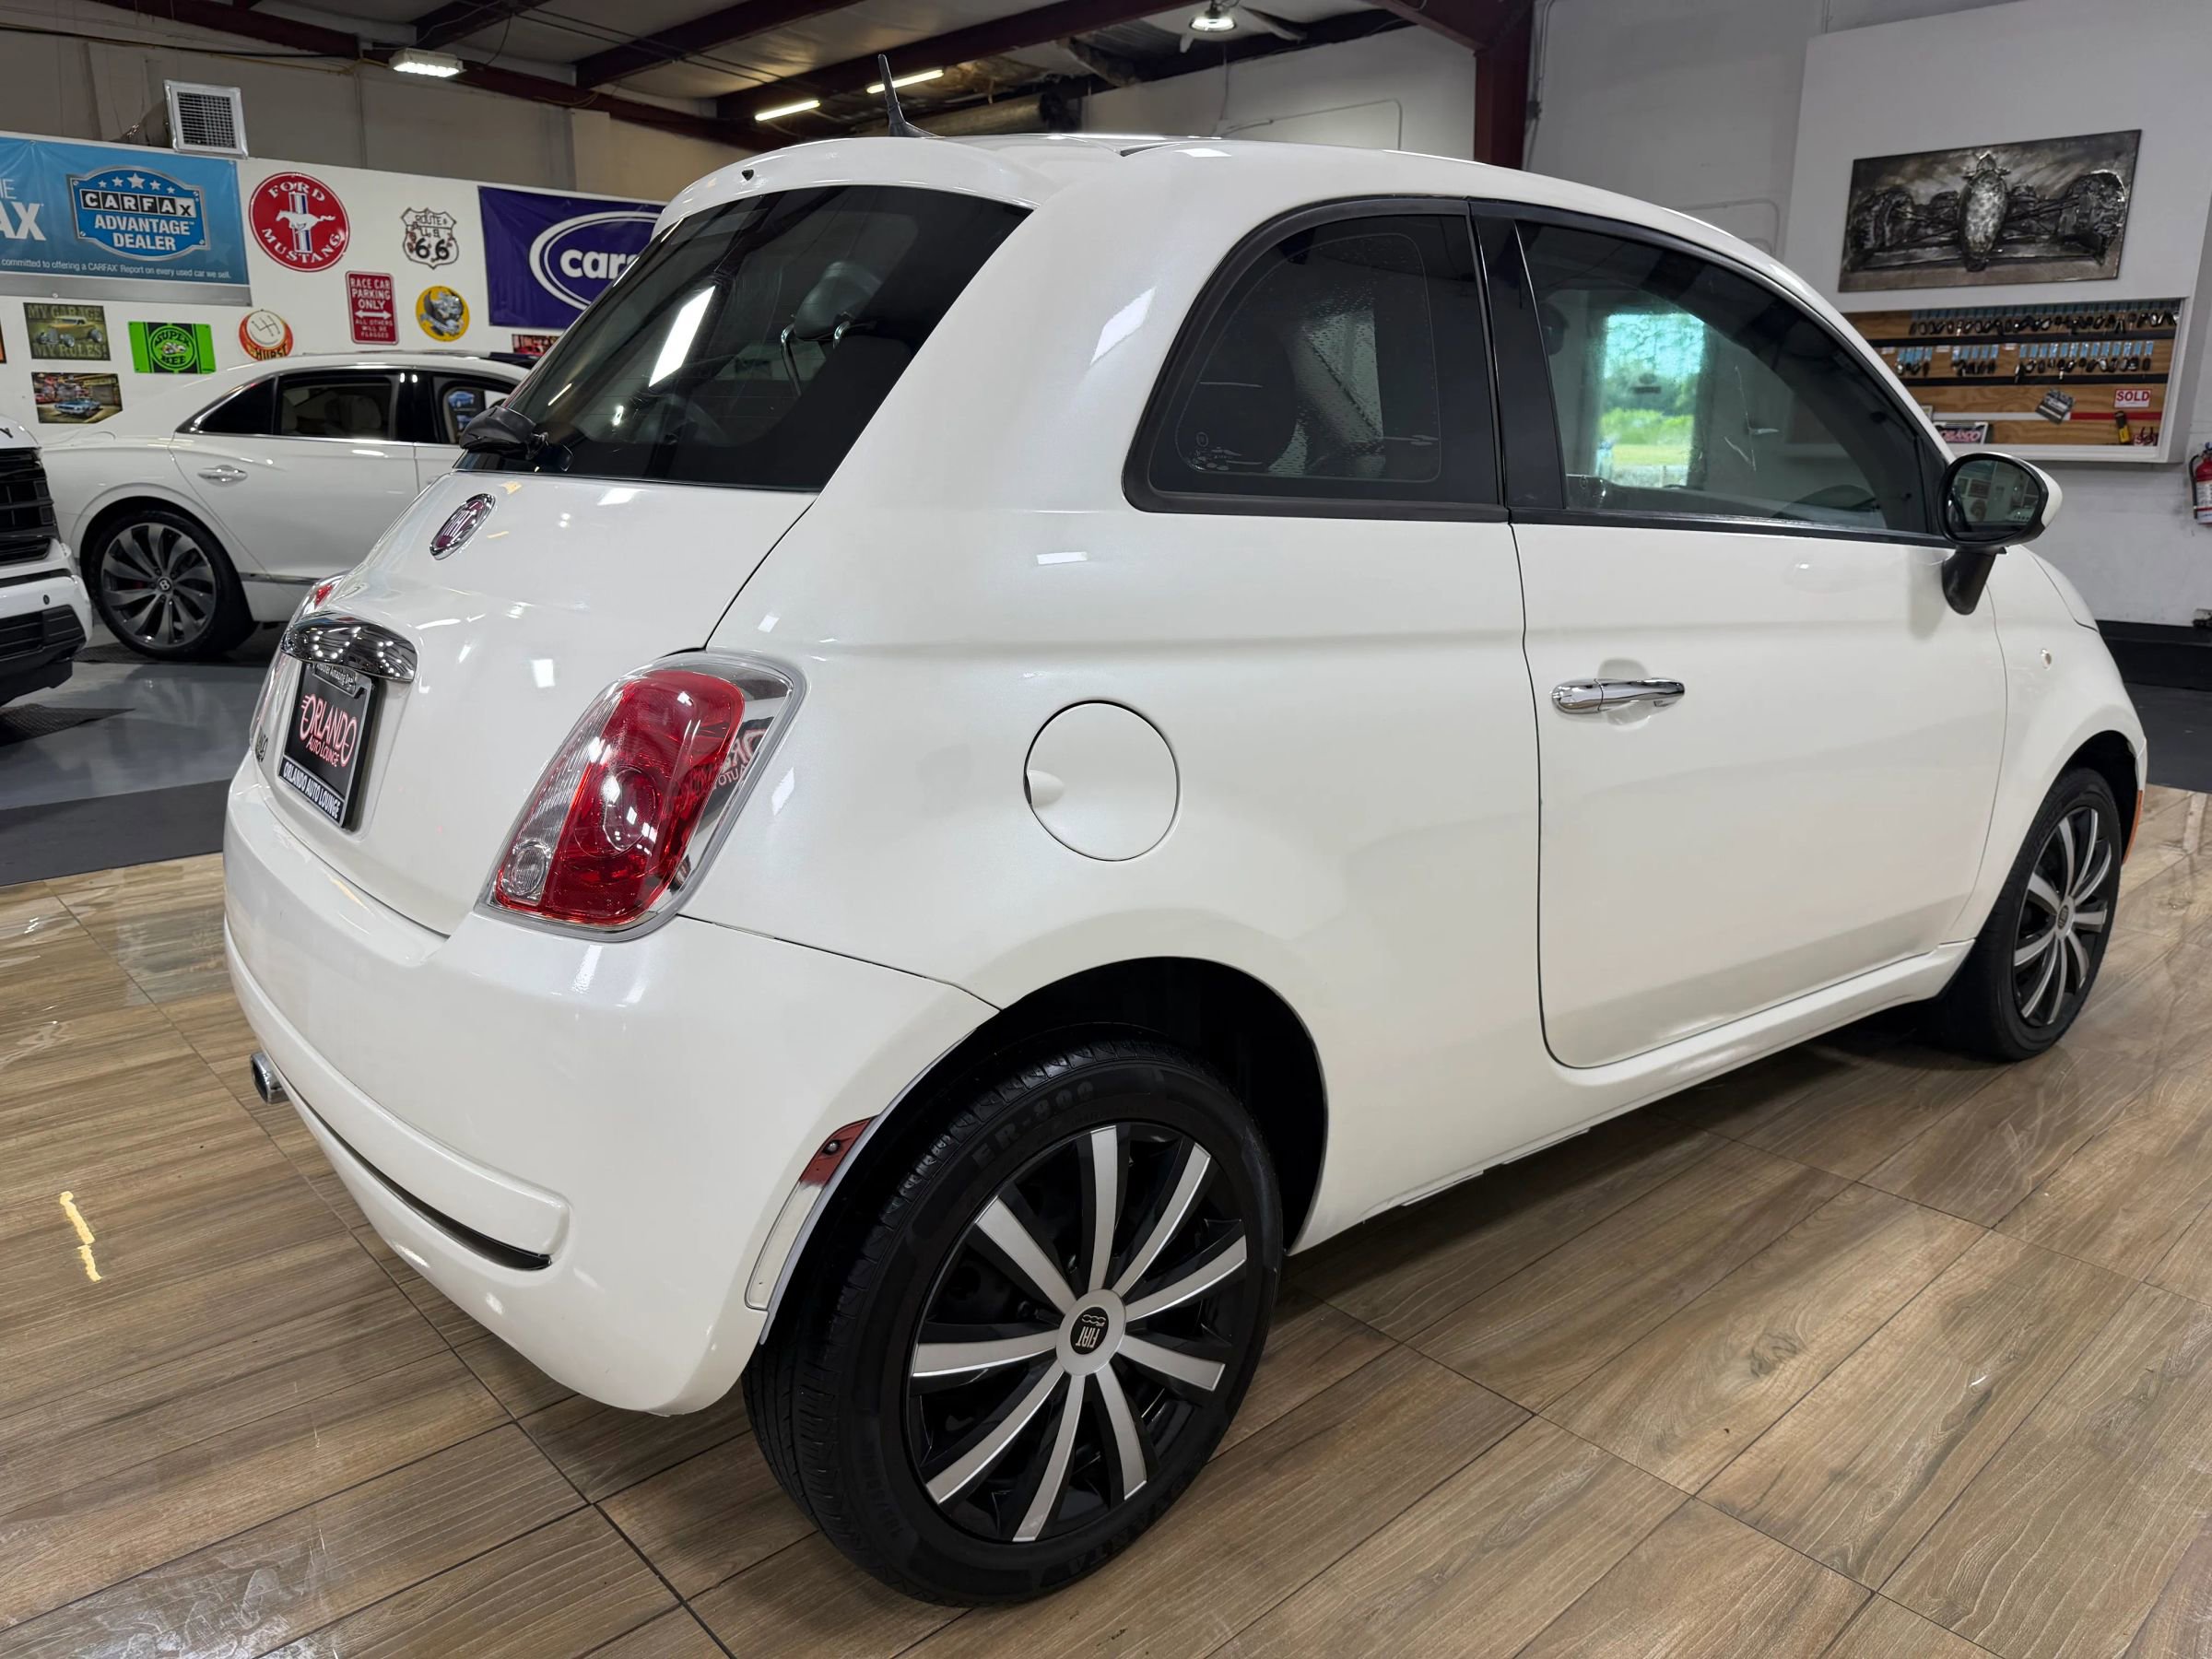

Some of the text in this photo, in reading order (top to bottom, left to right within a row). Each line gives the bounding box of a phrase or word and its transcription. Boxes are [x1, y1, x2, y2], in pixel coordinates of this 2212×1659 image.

[0, 178, 17, 199] E
[267, 182, 326, 201] FORD
[85, 192, 193, 217] CARFAX
[414, 213, 442, 226] ROUTE
[112, 232, 177, 252] DEALER
[262, 229, 345, 264] MUSTANG
[416, 237, 450, 260] 66
[2, 259, 41, 268] committed
[52, 262, 80, 271] offering
[120, 265, 145, 274] Report
[156, 268, 175, 276] every
[176, 269, 193, 277] used
[351, 277, 391, 289] RACE CAR
[352, 288, 391, 300] PARKING
[29, 305, 102, 321] MY GARAGE
[358, 300, 385, 311] ONLY
[33, 344, 57, 358] MY
[255, 342, 288, 361] HURST
[2116, 391, 2150, 402] SOLD
[300, 693, 358, 767] ORLANDO
[306, 735, 340, 768] AUTO LOUNGE
[283, 761, 341, 819] ORLANDO AUTO LOUNGE
[1075, 1326, 1100, 1347] FIAT
